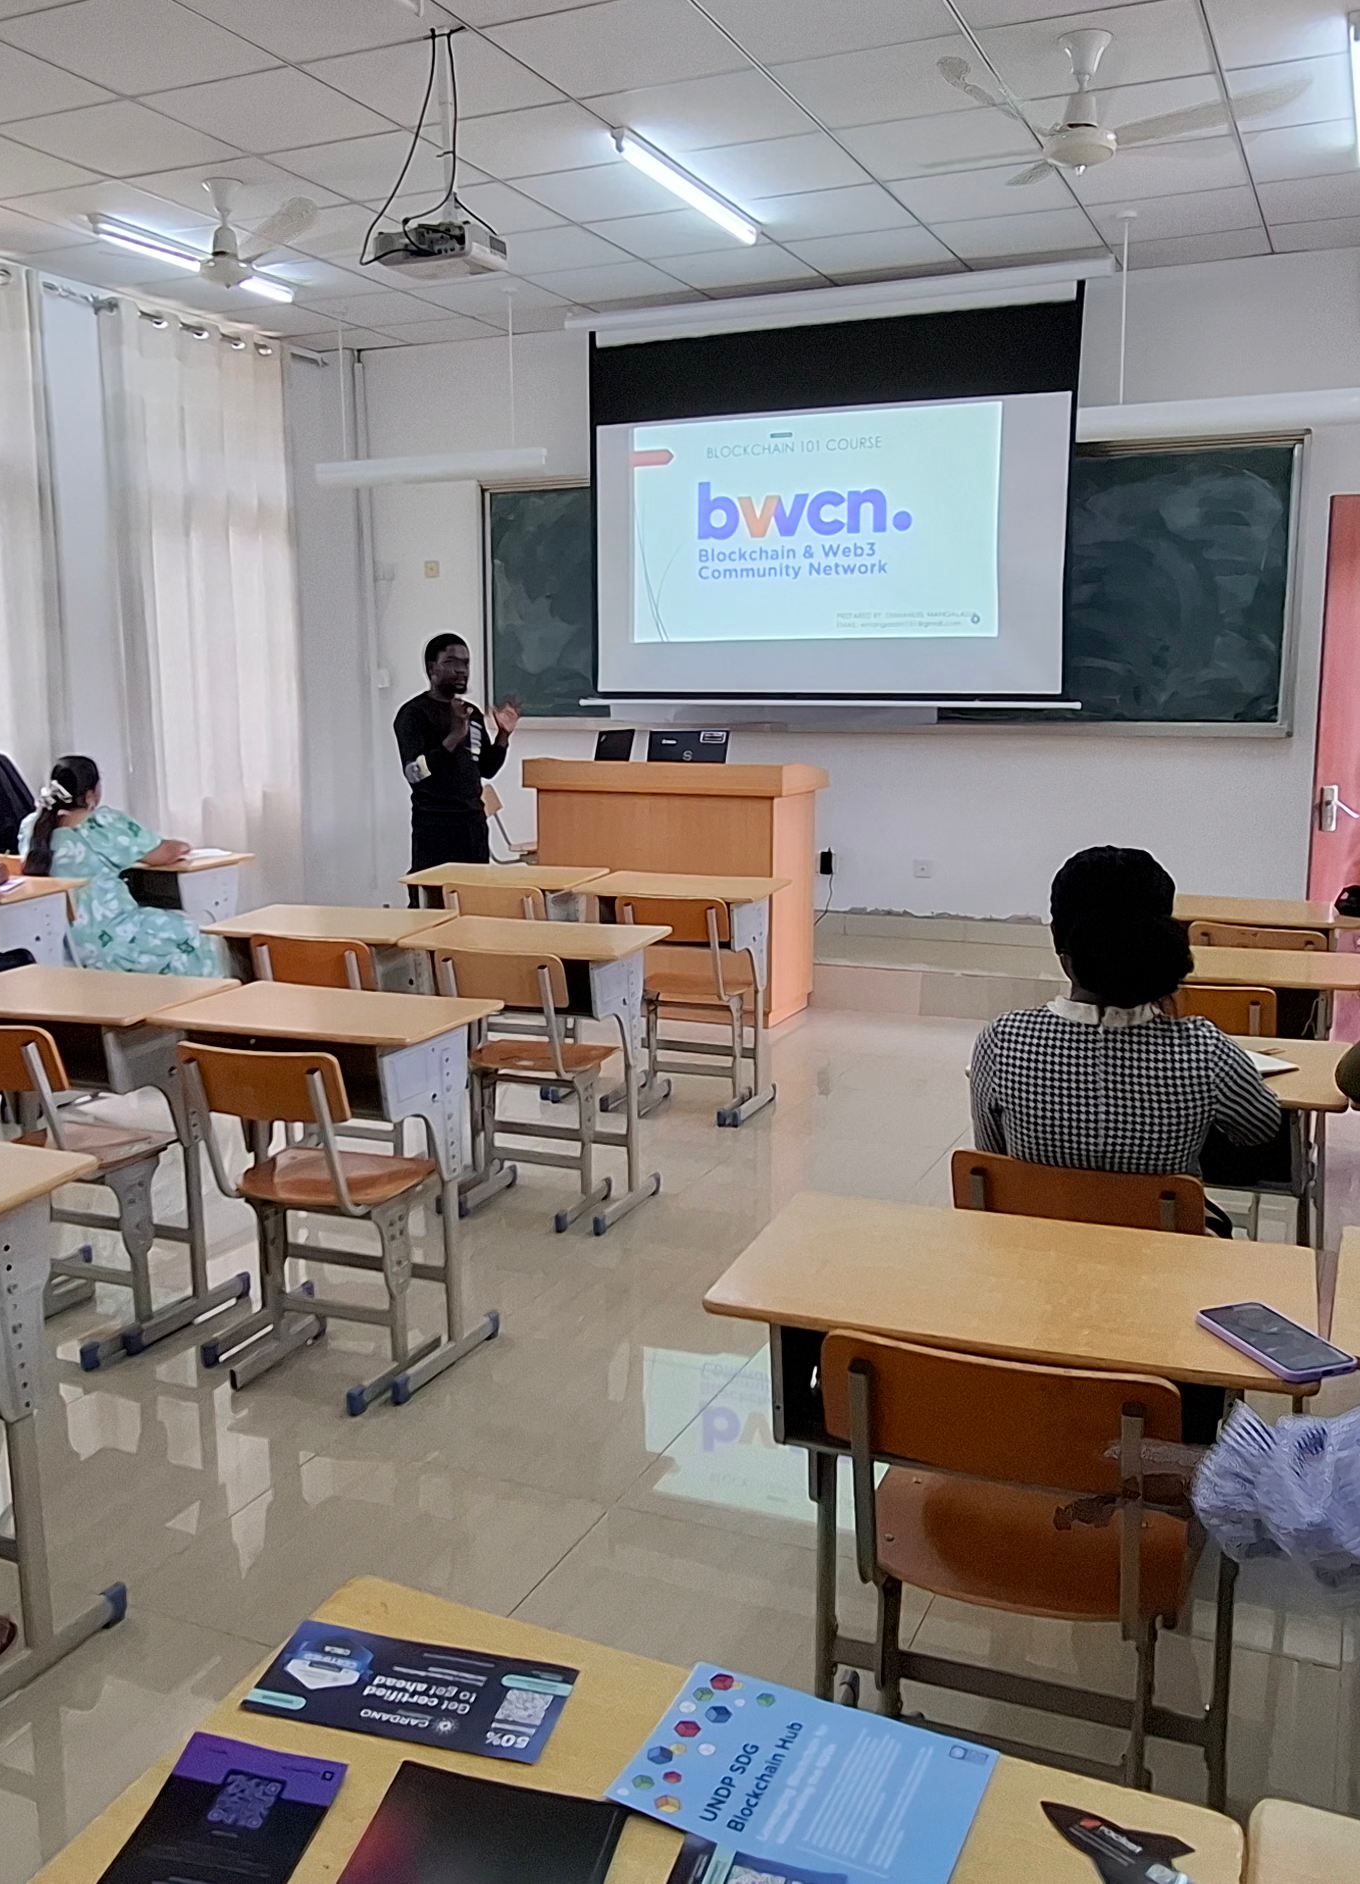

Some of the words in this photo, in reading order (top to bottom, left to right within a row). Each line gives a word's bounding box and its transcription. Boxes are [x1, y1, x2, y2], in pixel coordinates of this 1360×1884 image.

[706, 441, 795, 459] BLOCKCHAIN
[800, 439, 821, 454] 101
[825, 436, 883, 452] COURSE
[698, 545, 797, 563] Blockchain
[802, 545, 814, 560] &
[821, 542, 877, 559] Web3
[698, 563, 802, 581] Community
[808, 560, 888, 577] Network
[372, 1674, 428, 1694] ahead
[428, 1683, 459, 1699] get
[362, 1684, 440, 1708] certified
[461, 1690, 477, 1703] to
[441, 1699, 471, 1715] Get
[359, 1708, 430, 1729] CARDANO
[484, 1730, 531, 1749] 50%
[698, 1775, 737, 1822] UNDP
[728, 1742, 760, 1776] SDG
[726, 1751, 786, 1833] Blockchain
[774, 1721, 804, 1751] Hub
